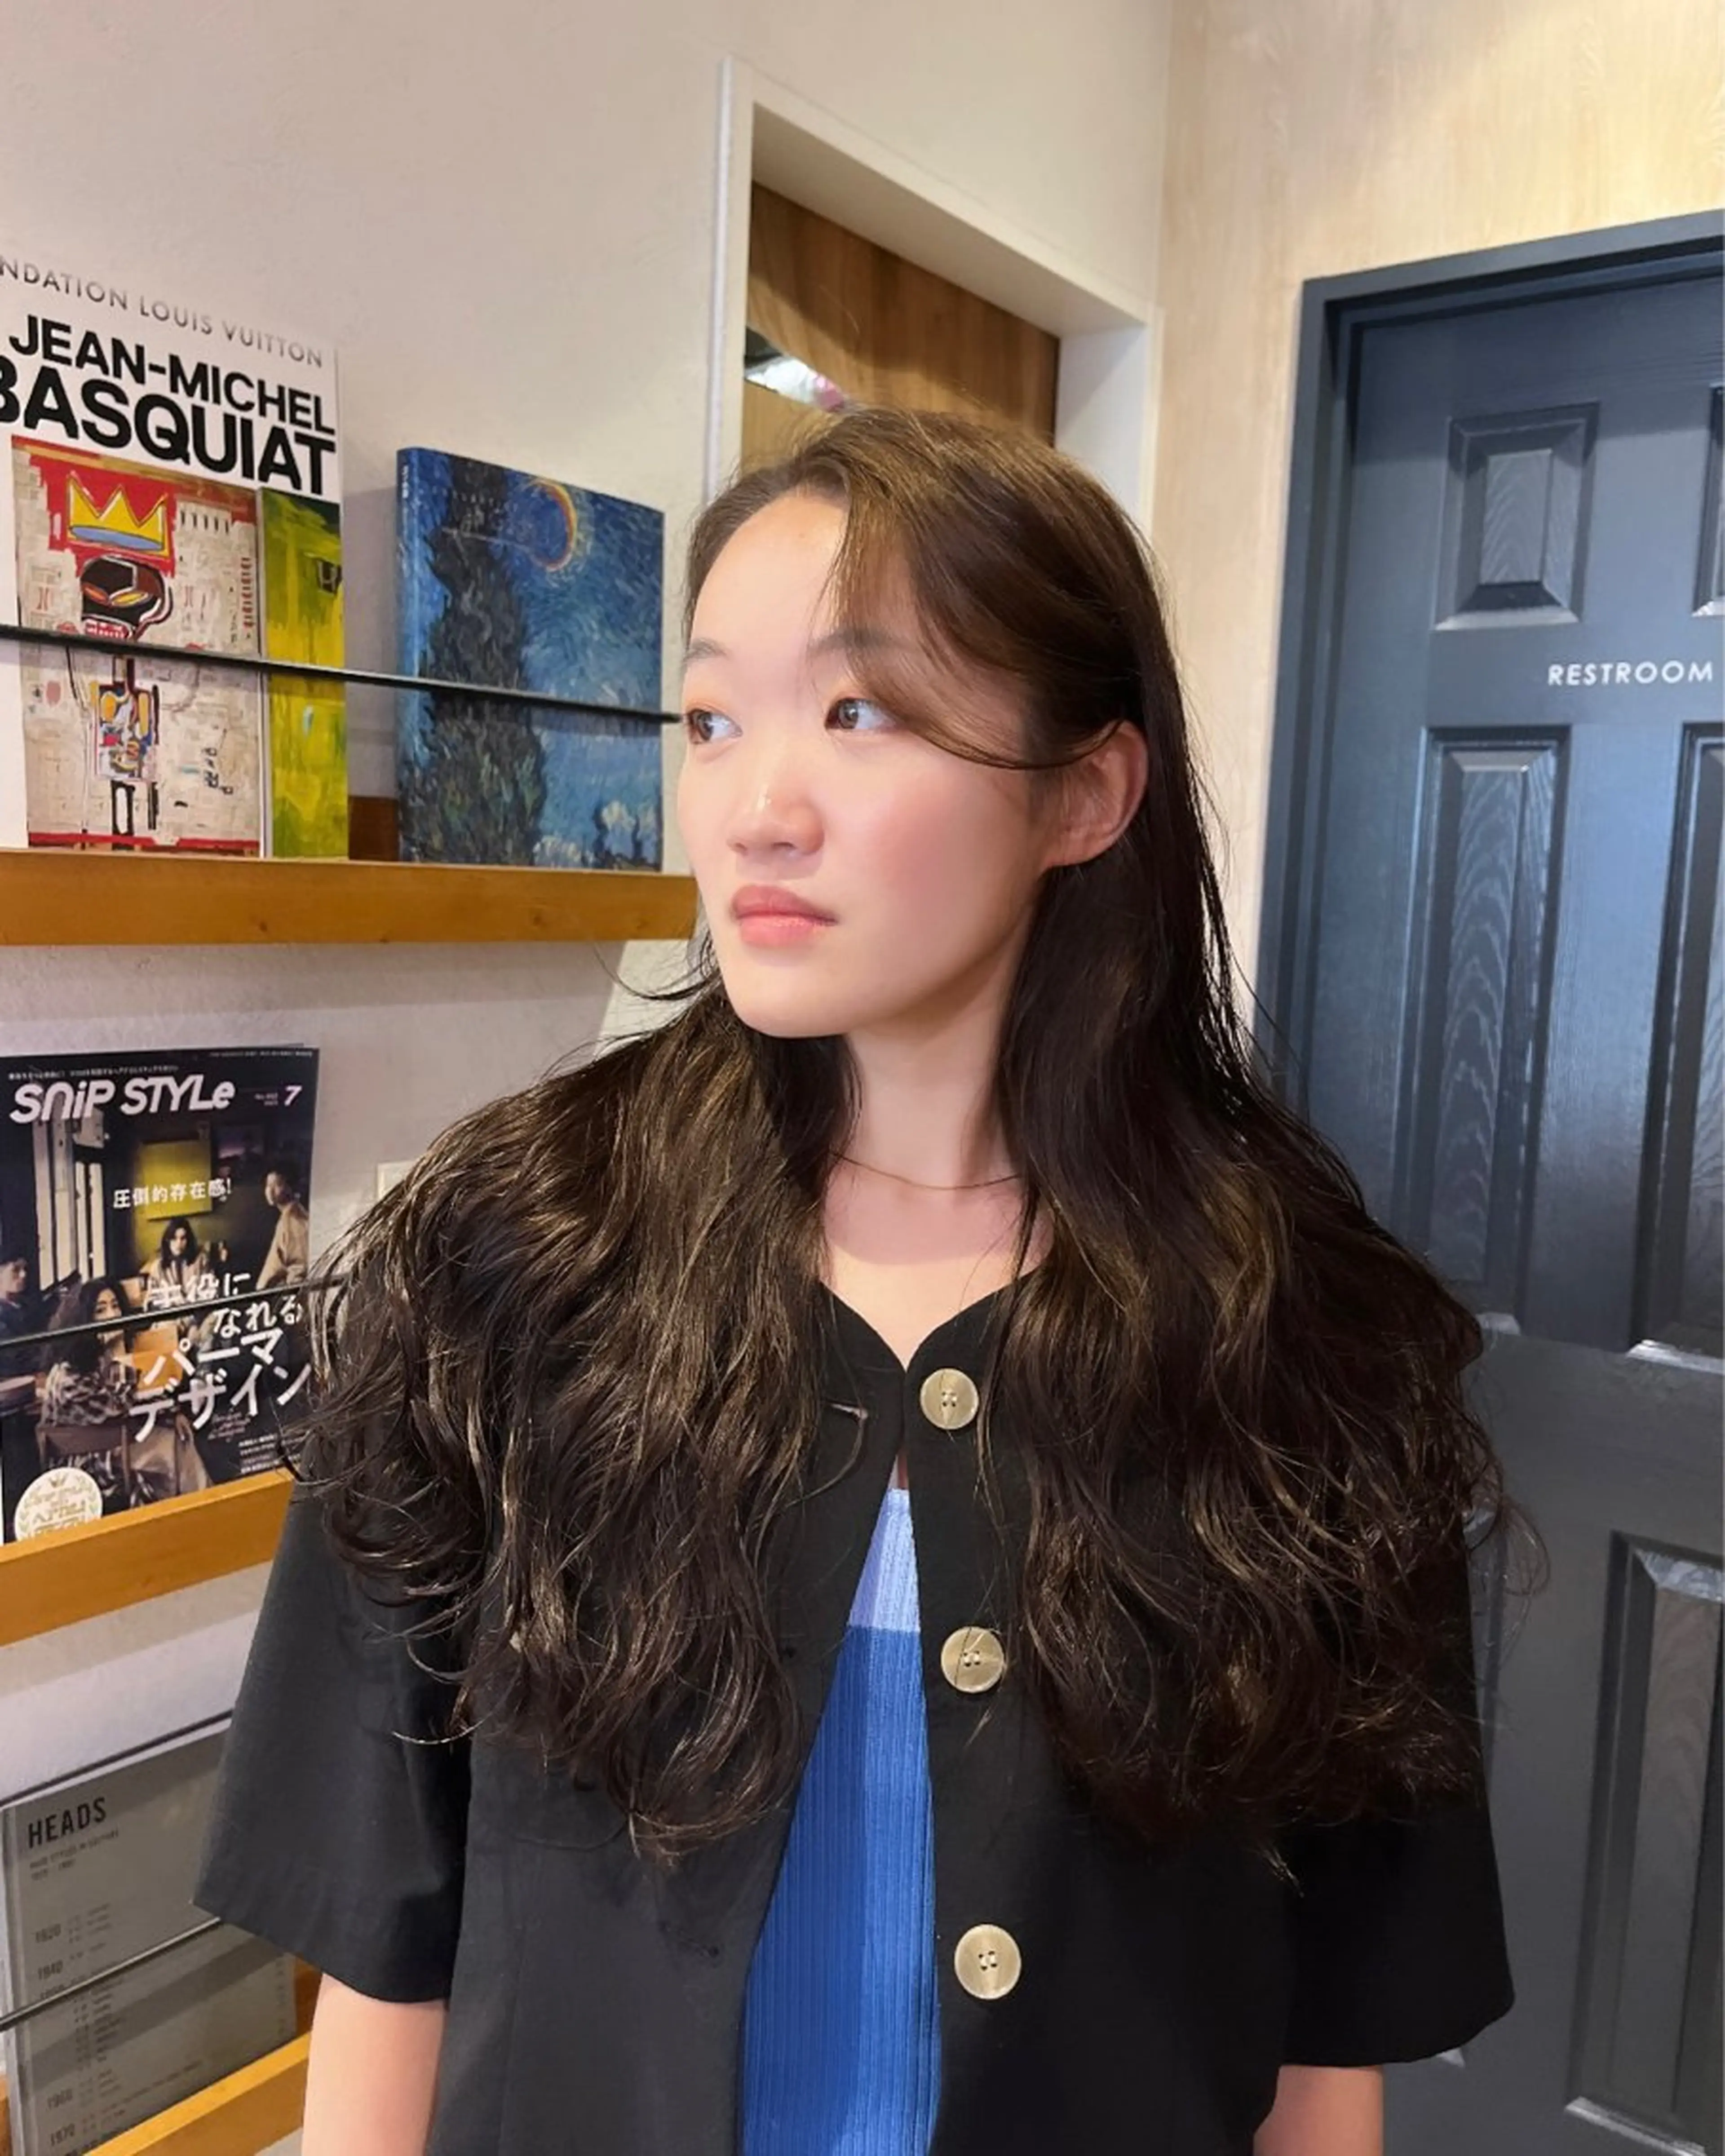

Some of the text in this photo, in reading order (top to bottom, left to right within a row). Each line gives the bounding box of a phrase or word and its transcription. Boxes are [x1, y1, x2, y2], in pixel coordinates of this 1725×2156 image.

[139, 296, 212, 335] LOUIS
[222, 321, 322, 367] VUITTON
[9, 314, 336, 435] JEAN-MICHEL
[1548, 660, 1713, 686] RESTROOM
[284, 1085, 302, 1106] 7
[143, 1328, 283, 1385] パーマ
[129, 1363, 311, 1442] デザイン
[29, 1797, 106, 1849] HEADS
